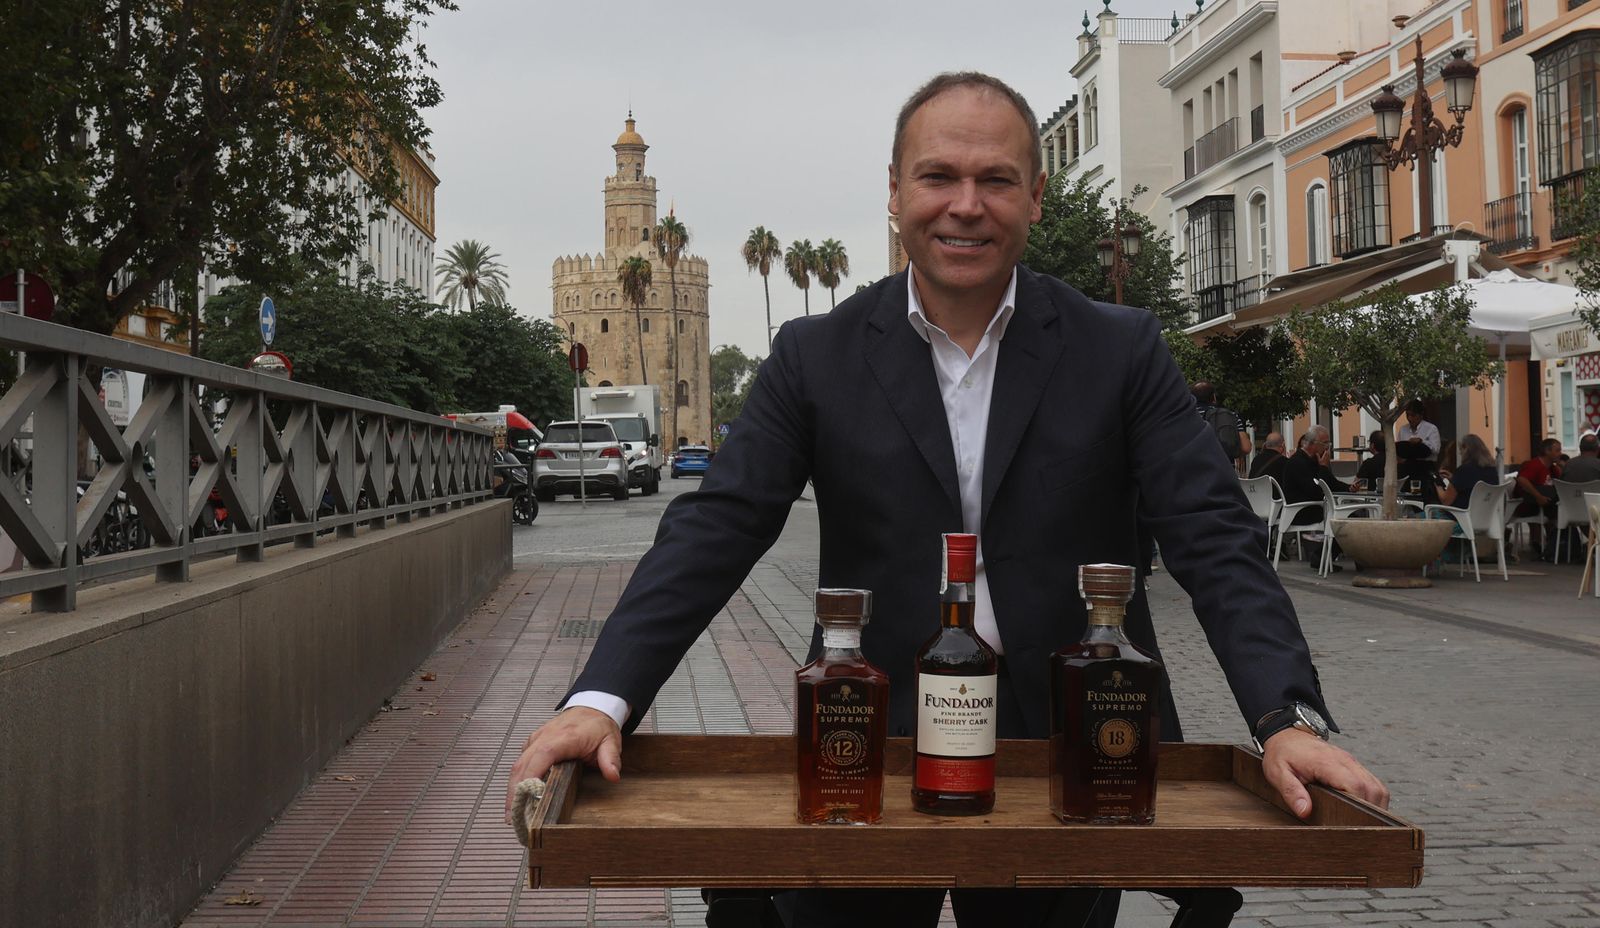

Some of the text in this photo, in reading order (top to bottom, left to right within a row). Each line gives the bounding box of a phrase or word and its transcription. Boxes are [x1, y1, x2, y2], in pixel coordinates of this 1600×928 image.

[925, 693, 994, 709] FUNDADOR
[1087, 690, 1147, 702] FUNDADOR
[815, 703, 874, 715] FUNDADOR
[969, 718, 988, 726] CASK
[1108, 730, 1125, 746] 18
[834, 741, 853, 756] 12
